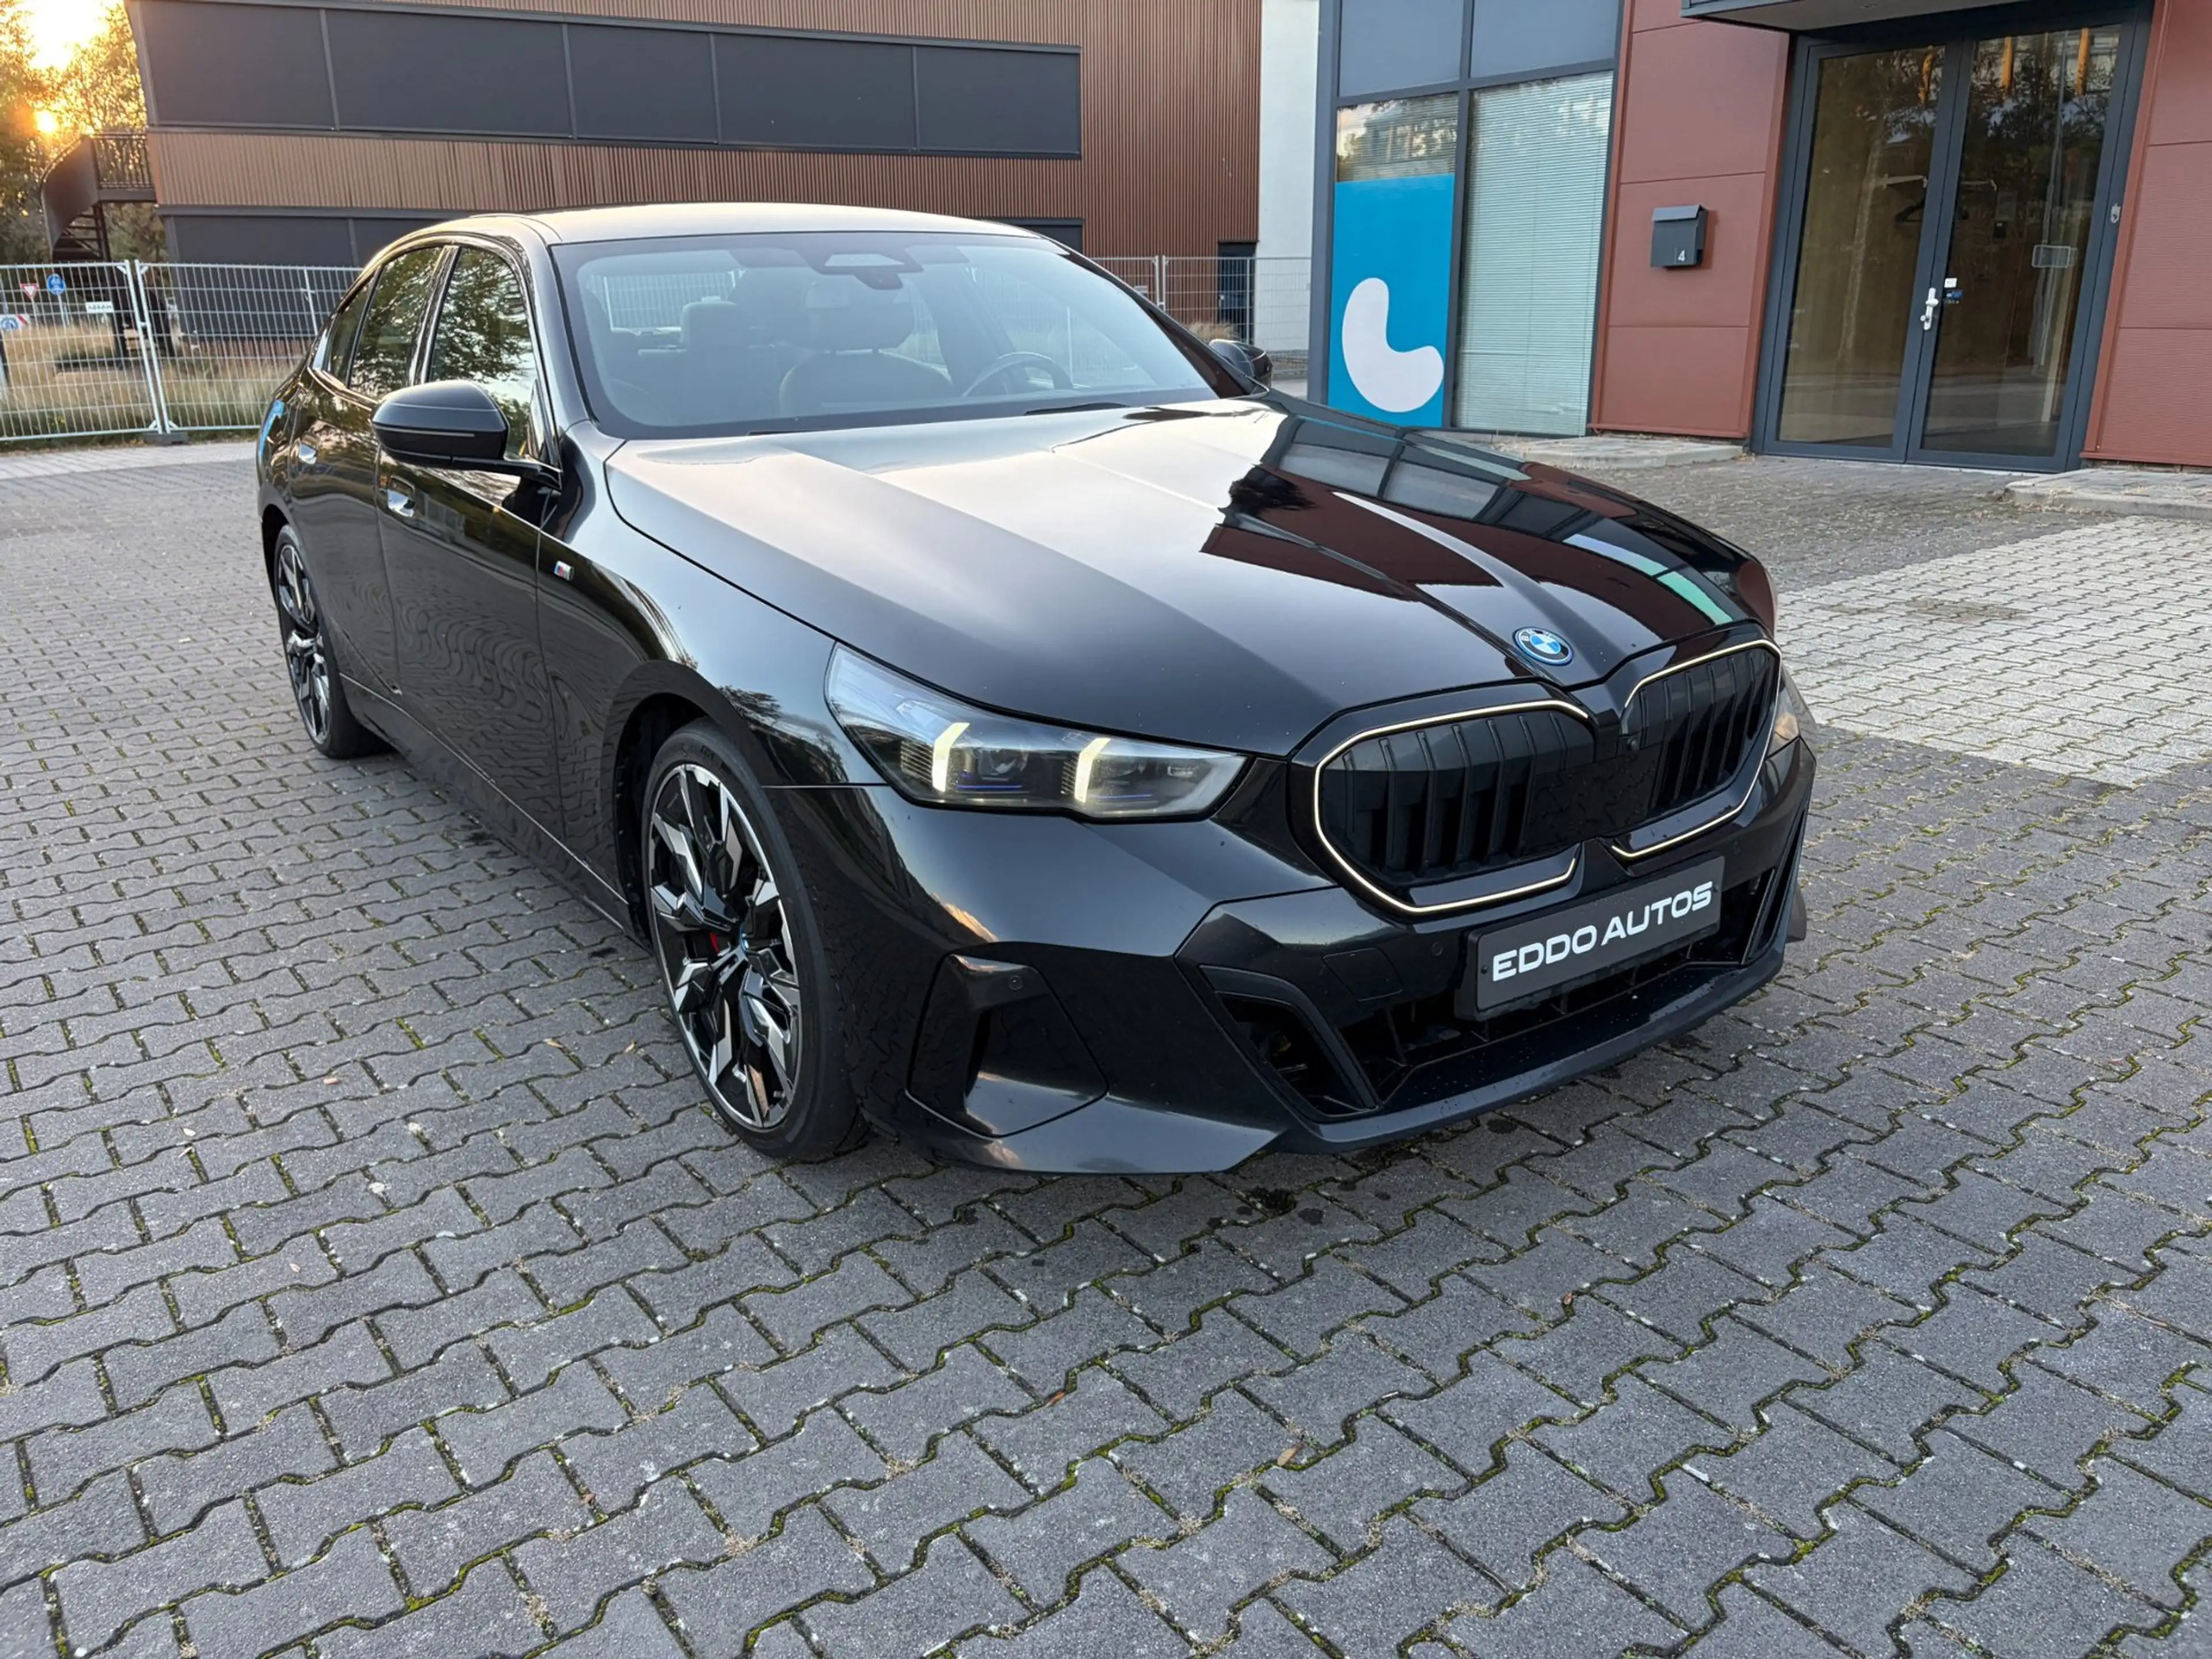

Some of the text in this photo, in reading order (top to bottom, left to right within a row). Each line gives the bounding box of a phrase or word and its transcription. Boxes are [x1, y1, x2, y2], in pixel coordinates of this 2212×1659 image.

[1677, 250, 1685, 262] 4
[1492, 881, 1713, 982] EDDO AUTOS
